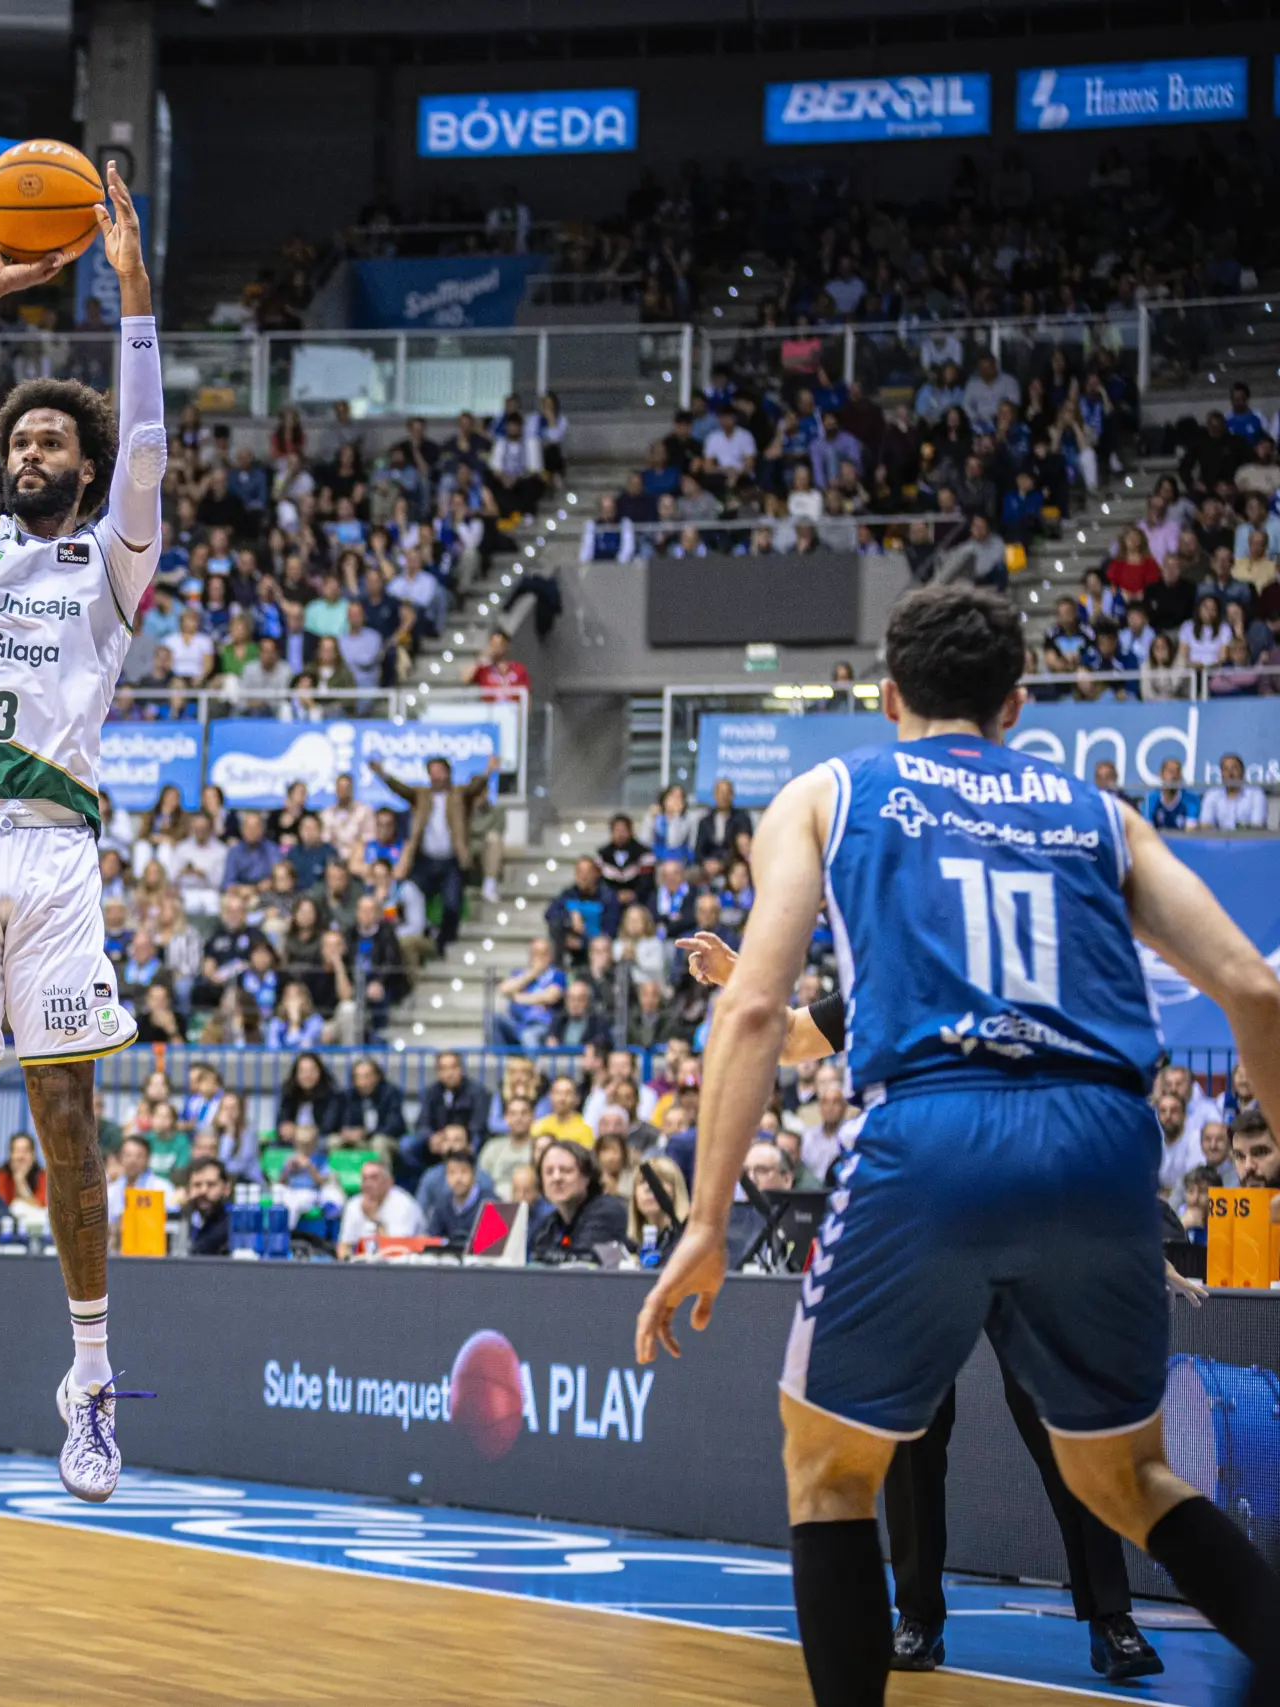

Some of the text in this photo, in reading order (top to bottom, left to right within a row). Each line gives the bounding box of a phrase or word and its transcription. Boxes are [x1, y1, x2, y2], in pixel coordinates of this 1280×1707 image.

[427, 98, 627, 151] BÓVEDA
[60, 555, 88, 563] endesa
[100, 732, 197, 764] dología
[939, 858, 1060, 1006] 10
[42, 985, 72, 996] sabor
[42, 990, 88, 1013] a má
[44, 1011, 89, 1036] laga
[263, 1360, 321, 1410] Sube
[327, 1366, 351, 1413] tu
[357, 1374, 452, 1431] maquet
[548, 1364, 655, 1442] PLAY
